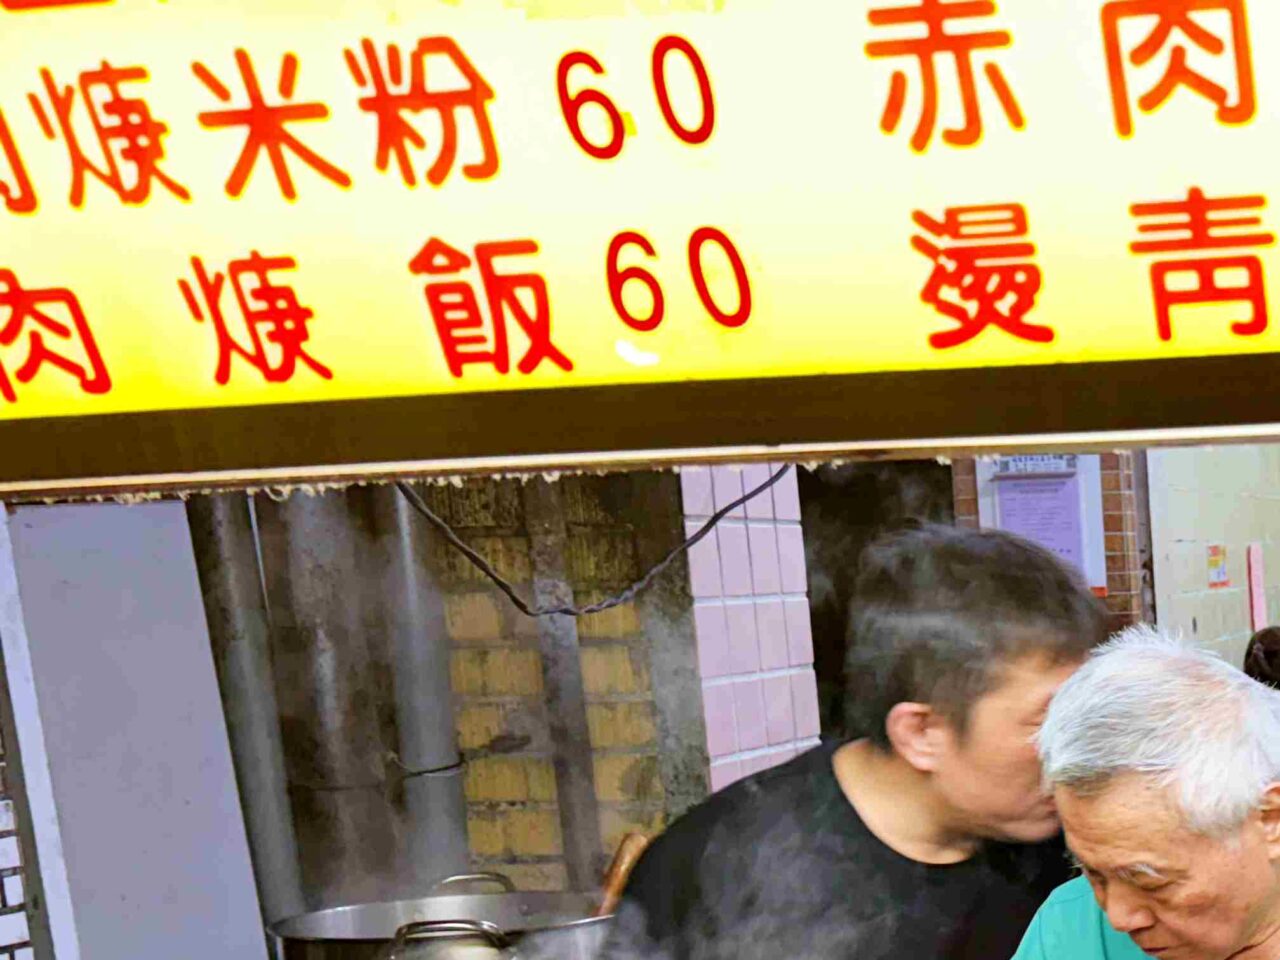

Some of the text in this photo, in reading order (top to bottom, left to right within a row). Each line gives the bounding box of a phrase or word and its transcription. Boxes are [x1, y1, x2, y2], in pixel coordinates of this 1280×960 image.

[0, 34, 716, 214] 焿米粉 60
[605, 226, 753, 332] 60
